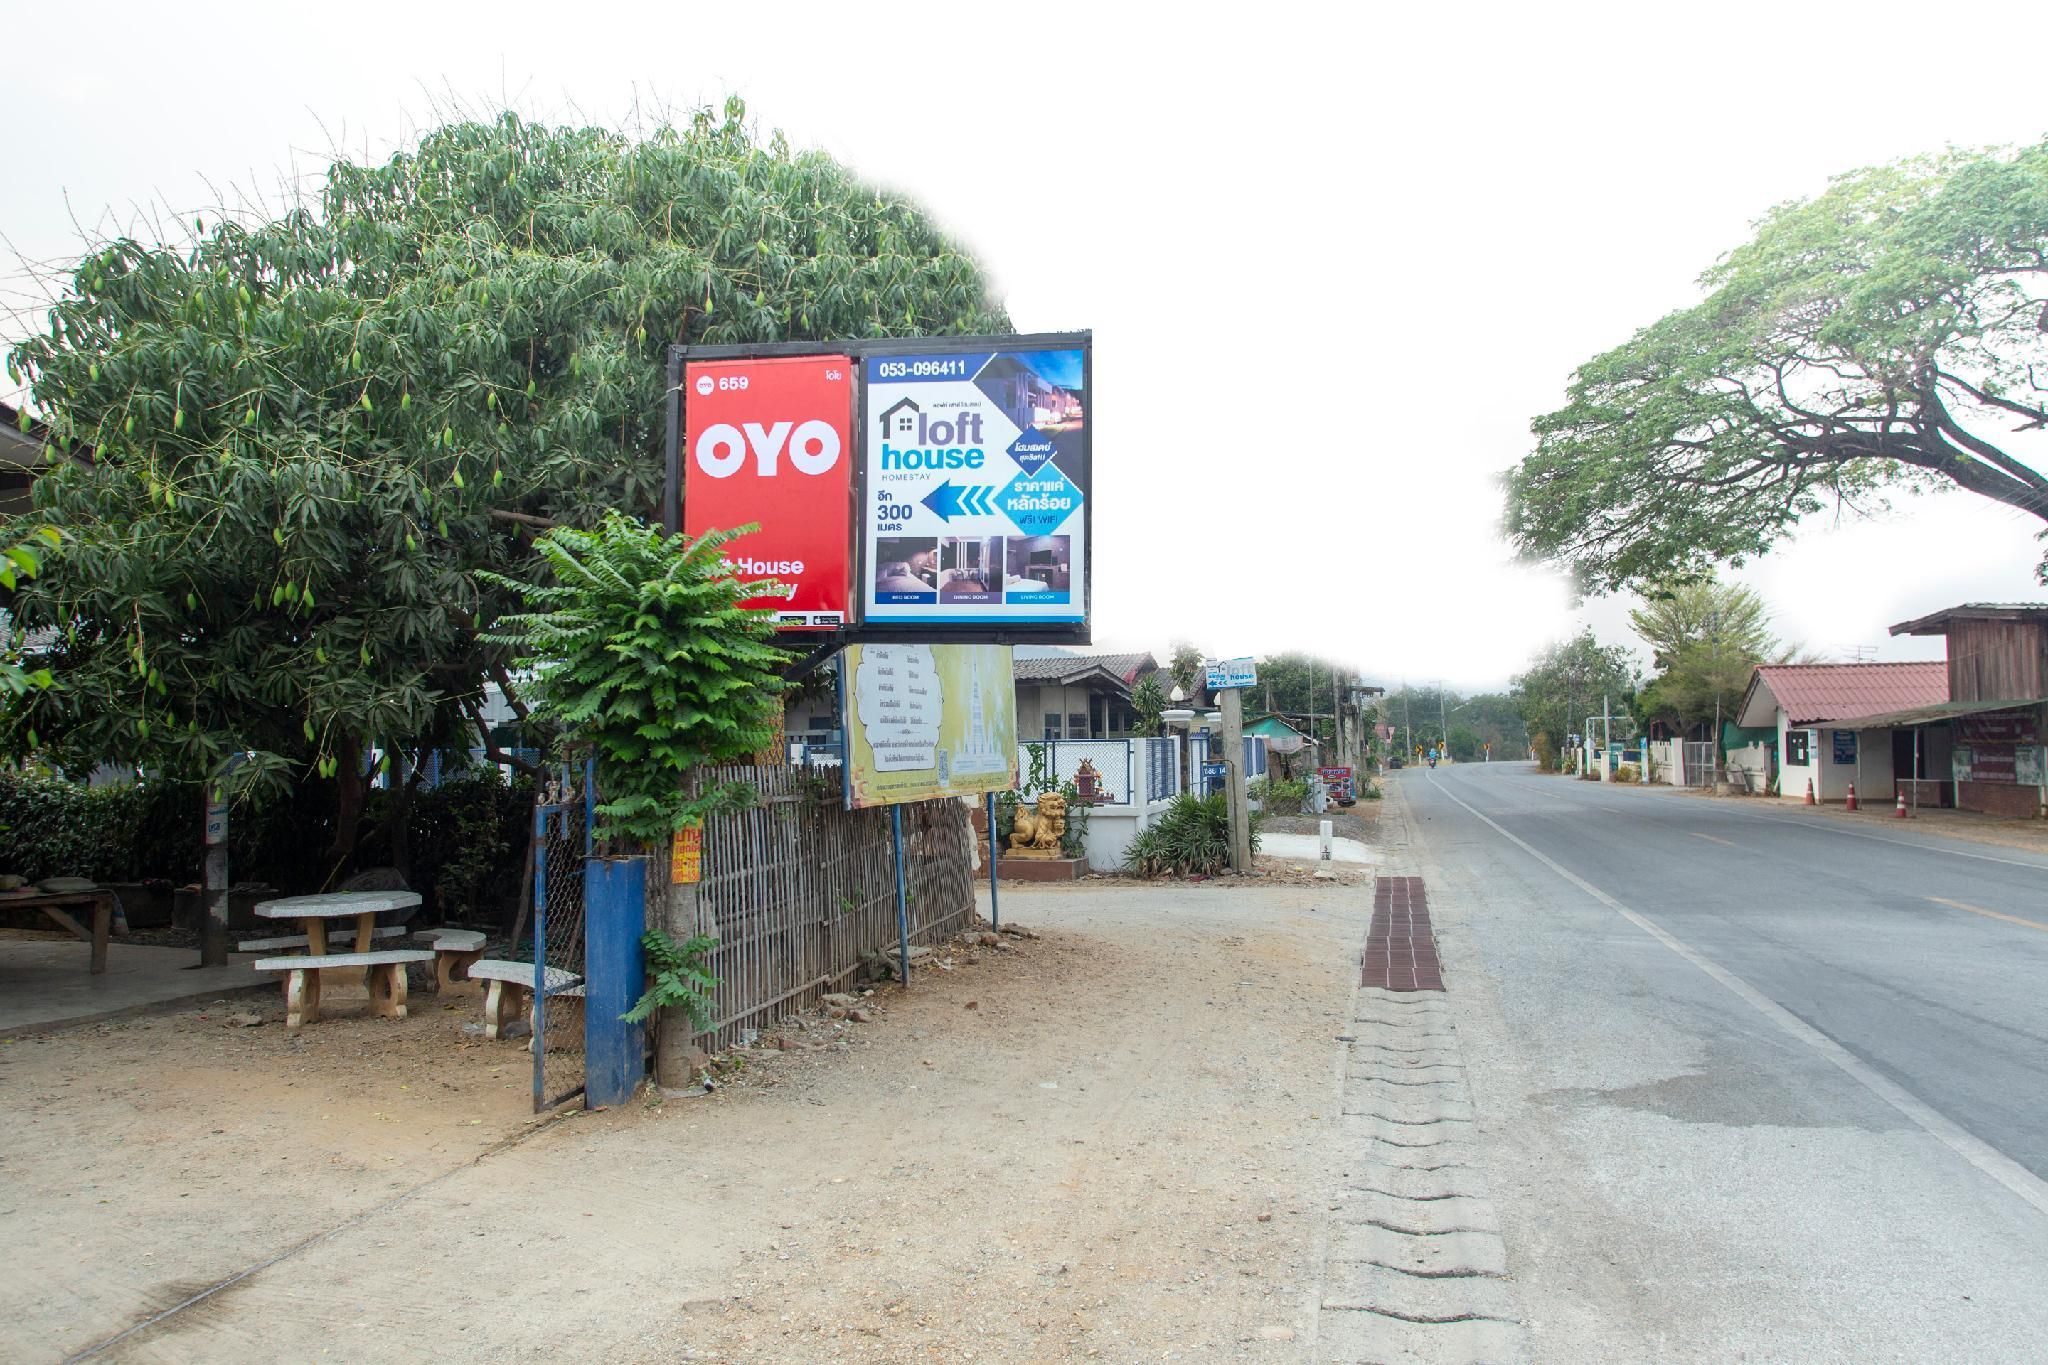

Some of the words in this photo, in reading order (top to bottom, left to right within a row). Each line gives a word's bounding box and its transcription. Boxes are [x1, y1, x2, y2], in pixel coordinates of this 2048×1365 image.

[880, 360, 966, 378] 053-096411
[718, 376, 749, 391] 659
[918, 411, 984, 446] loft
[696, 420, 841, 478] OYO
[881, 443, 985, 470] house
[881, 473, 931, 482] HOMESTAY
[1014, 477, 1065, 492] ราคาแค่
[877, 490, 893, 502] อีก
[1007, 493, 1071, 511] หลักร้อย
[877, 504, 913, 521] 300
[877, 523, 903, 532] เมตร
[737, 557, 804, 575] House
